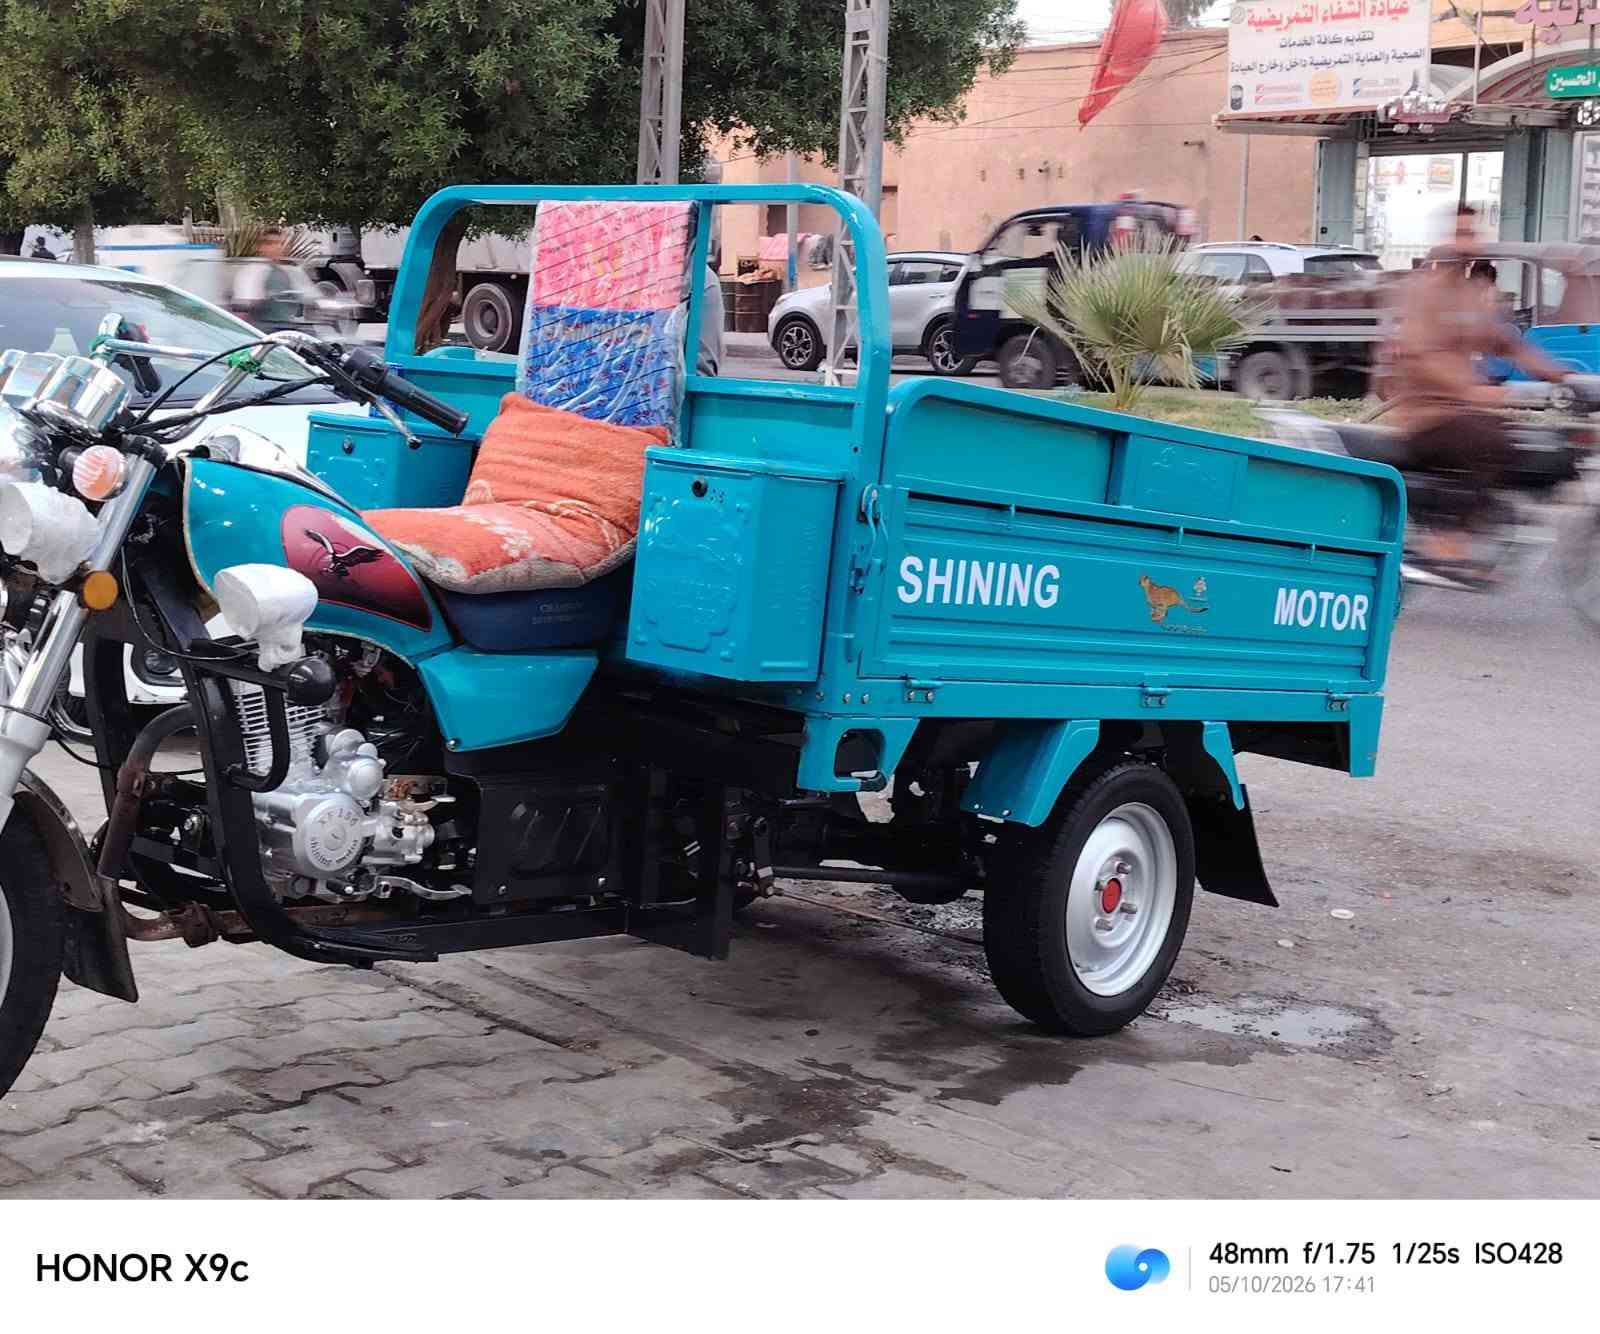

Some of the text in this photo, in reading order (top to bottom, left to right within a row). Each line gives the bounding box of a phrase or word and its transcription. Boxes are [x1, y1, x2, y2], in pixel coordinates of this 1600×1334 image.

[1247, 0, 1409, 32] عيادة الشفاء التمريضية
[1279, 30, 1375, 49] لتقديم كافة الخدمات
[1309, 54, 1356, 69] التمريضية
[1391, 48, 1425, 61] الصحية
[1550, 70, 1597, 92] الحسين
[898, 556, 1060, 608] SHINING
[1274, 588, 1369, 631] MOTOR
